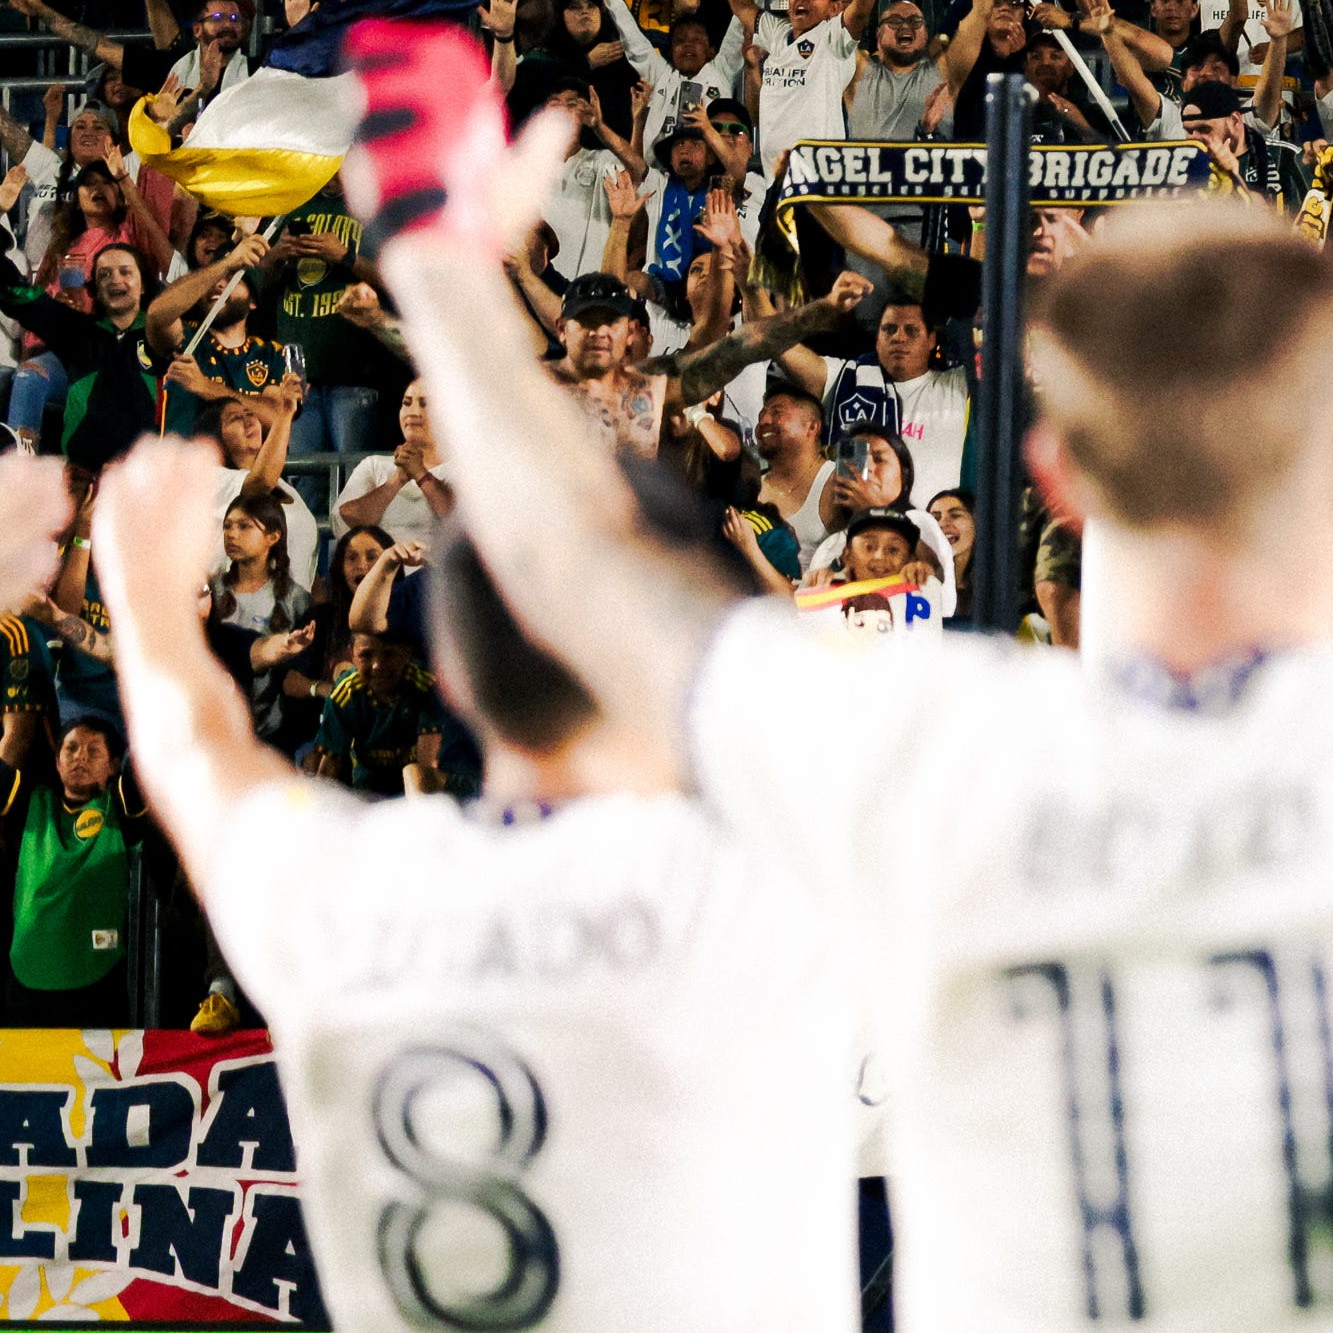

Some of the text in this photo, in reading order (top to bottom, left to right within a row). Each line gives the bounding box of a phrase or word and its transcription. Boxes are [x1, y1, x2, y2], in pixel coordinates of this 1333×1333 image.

[1212, 9, 1268, 22] HELIFE
[790, 146, 893, 183] NGEL
[904, 148, 989, 184] CITY
[845, 408, 866, 422] LA
[372, 1036, 561, 1332] 8
